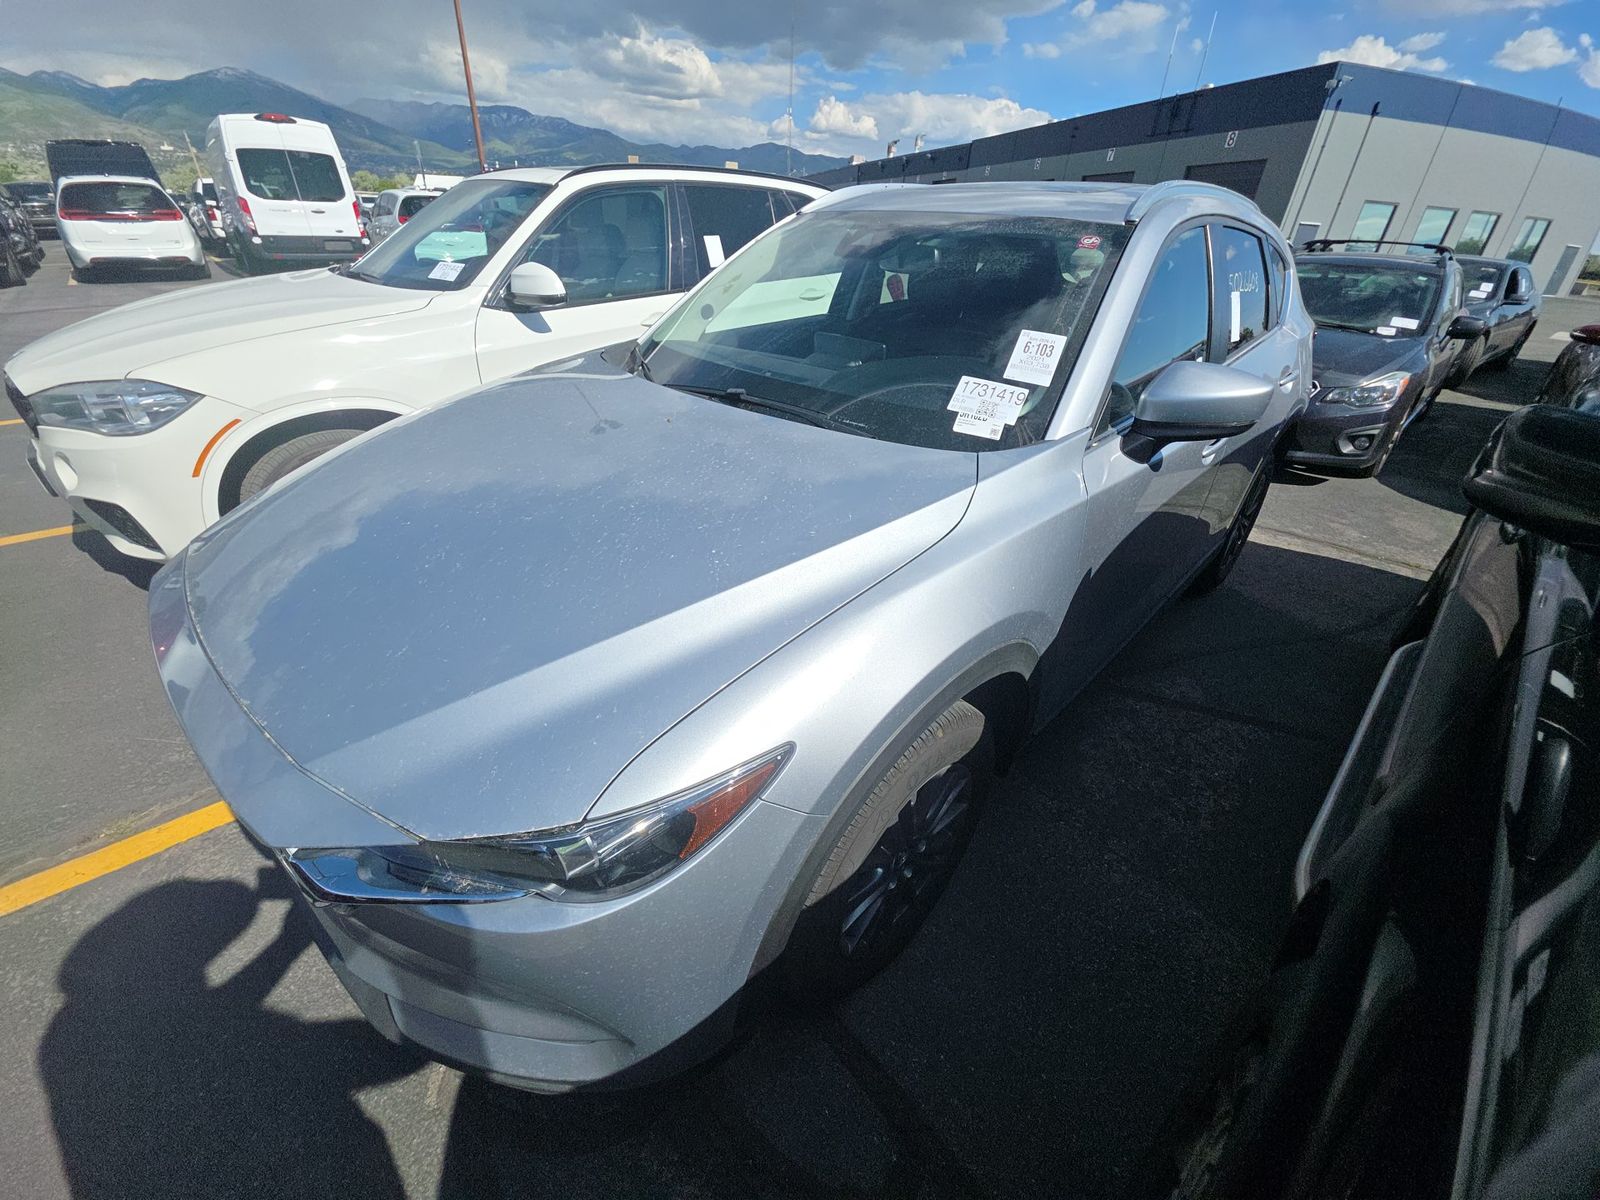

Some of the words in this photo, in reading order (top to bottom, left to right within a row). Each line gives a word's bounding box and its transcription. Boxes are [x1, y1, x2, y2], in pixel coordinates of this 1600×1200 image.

[1226, 131, 1238, 148] 8
[1107, 147, 1116, 161] 7
[1023, 340, 1055, 358] 6:103
[962, 380, 1027, 406] 1731419
